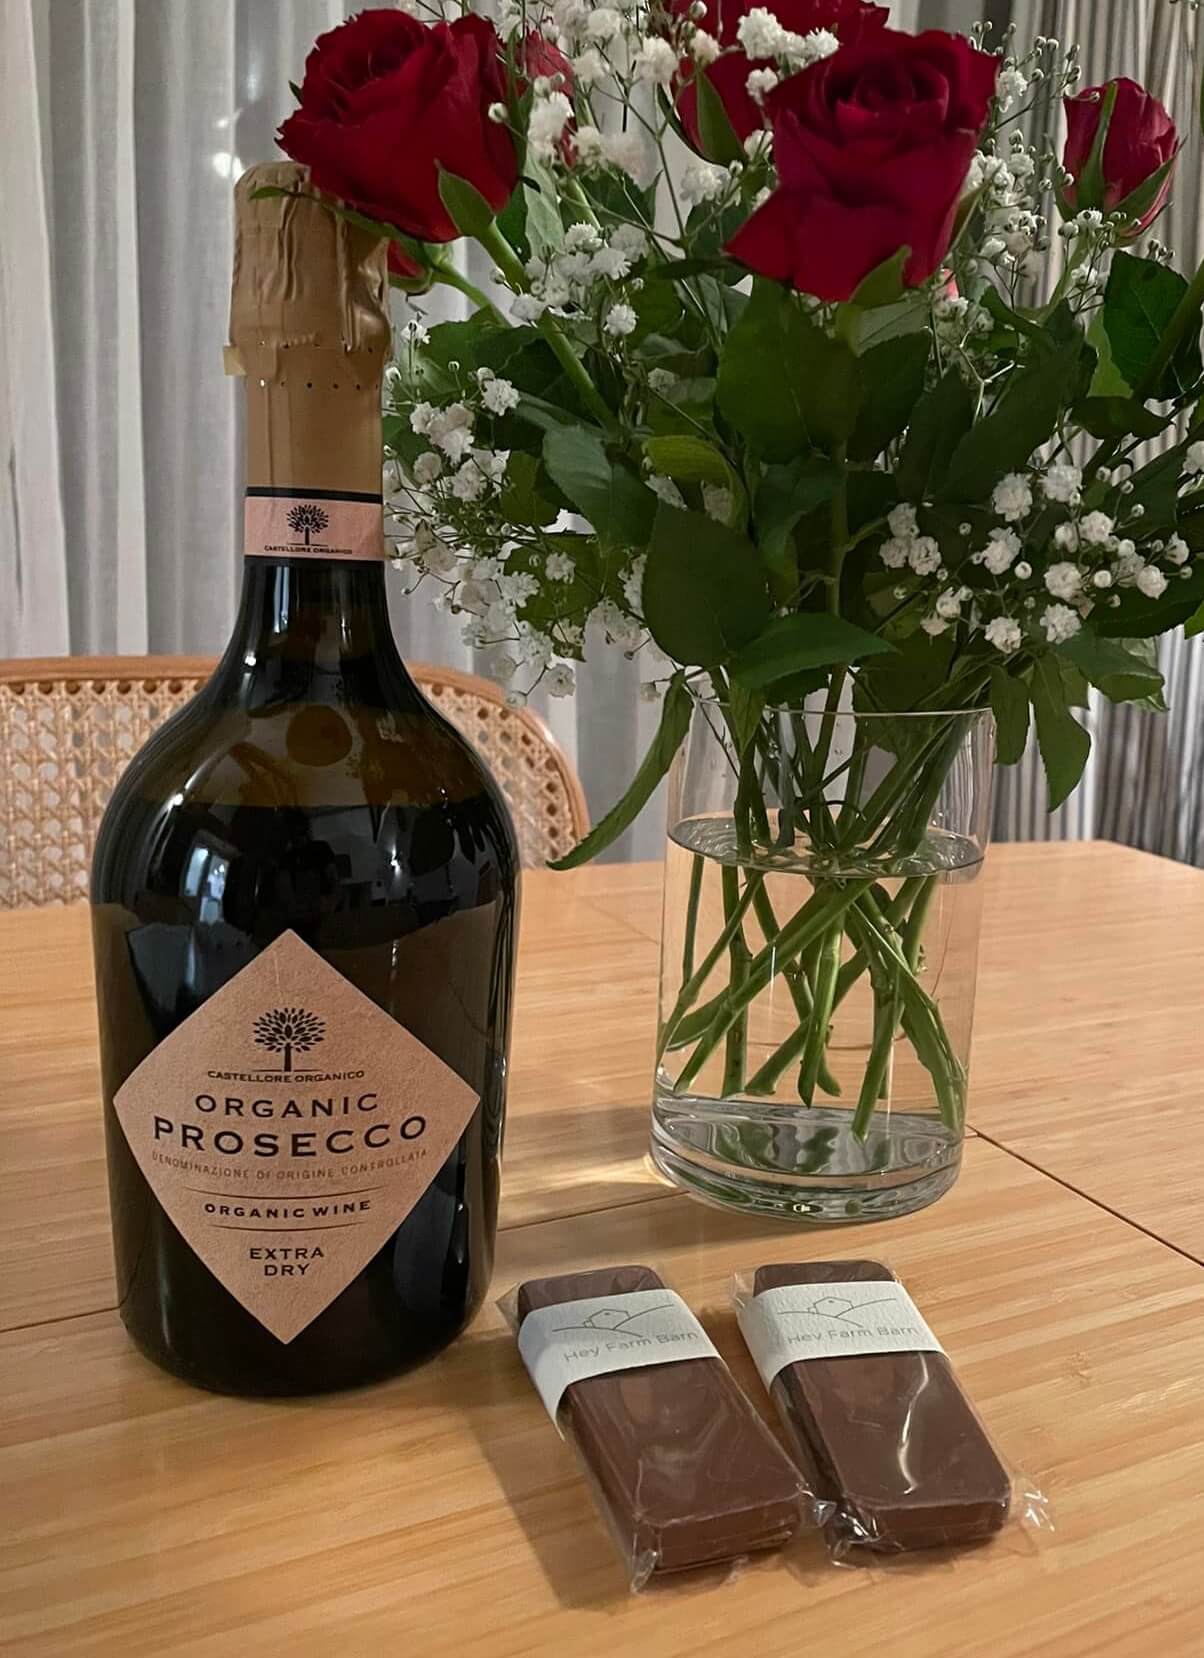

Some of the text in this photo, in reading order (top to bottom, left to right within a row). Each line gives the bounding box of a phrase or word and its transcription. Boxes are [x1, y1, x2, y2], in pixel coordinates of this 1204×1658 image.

[207, 1070, 365, 1083] CASTELLORE ORGANICO
[195, 1093, 378, 1119] ORGANIC
[153, 1115, 426, 1158] PROSECCO
[152, 1149, 428, 1180] DENOMINAZIONE DI ORIGINE CONTROLLATA
[204, 1200, 371, 1219] ORGANIC WINE
[250, 1247, 325, 1260] EXTRA
[264, 1264, 310, 1276] DRY
[787, 1326, 919, 1345] Hey Farm Barn
[563, 1332, 699, 1363] Hey Farm Barn
